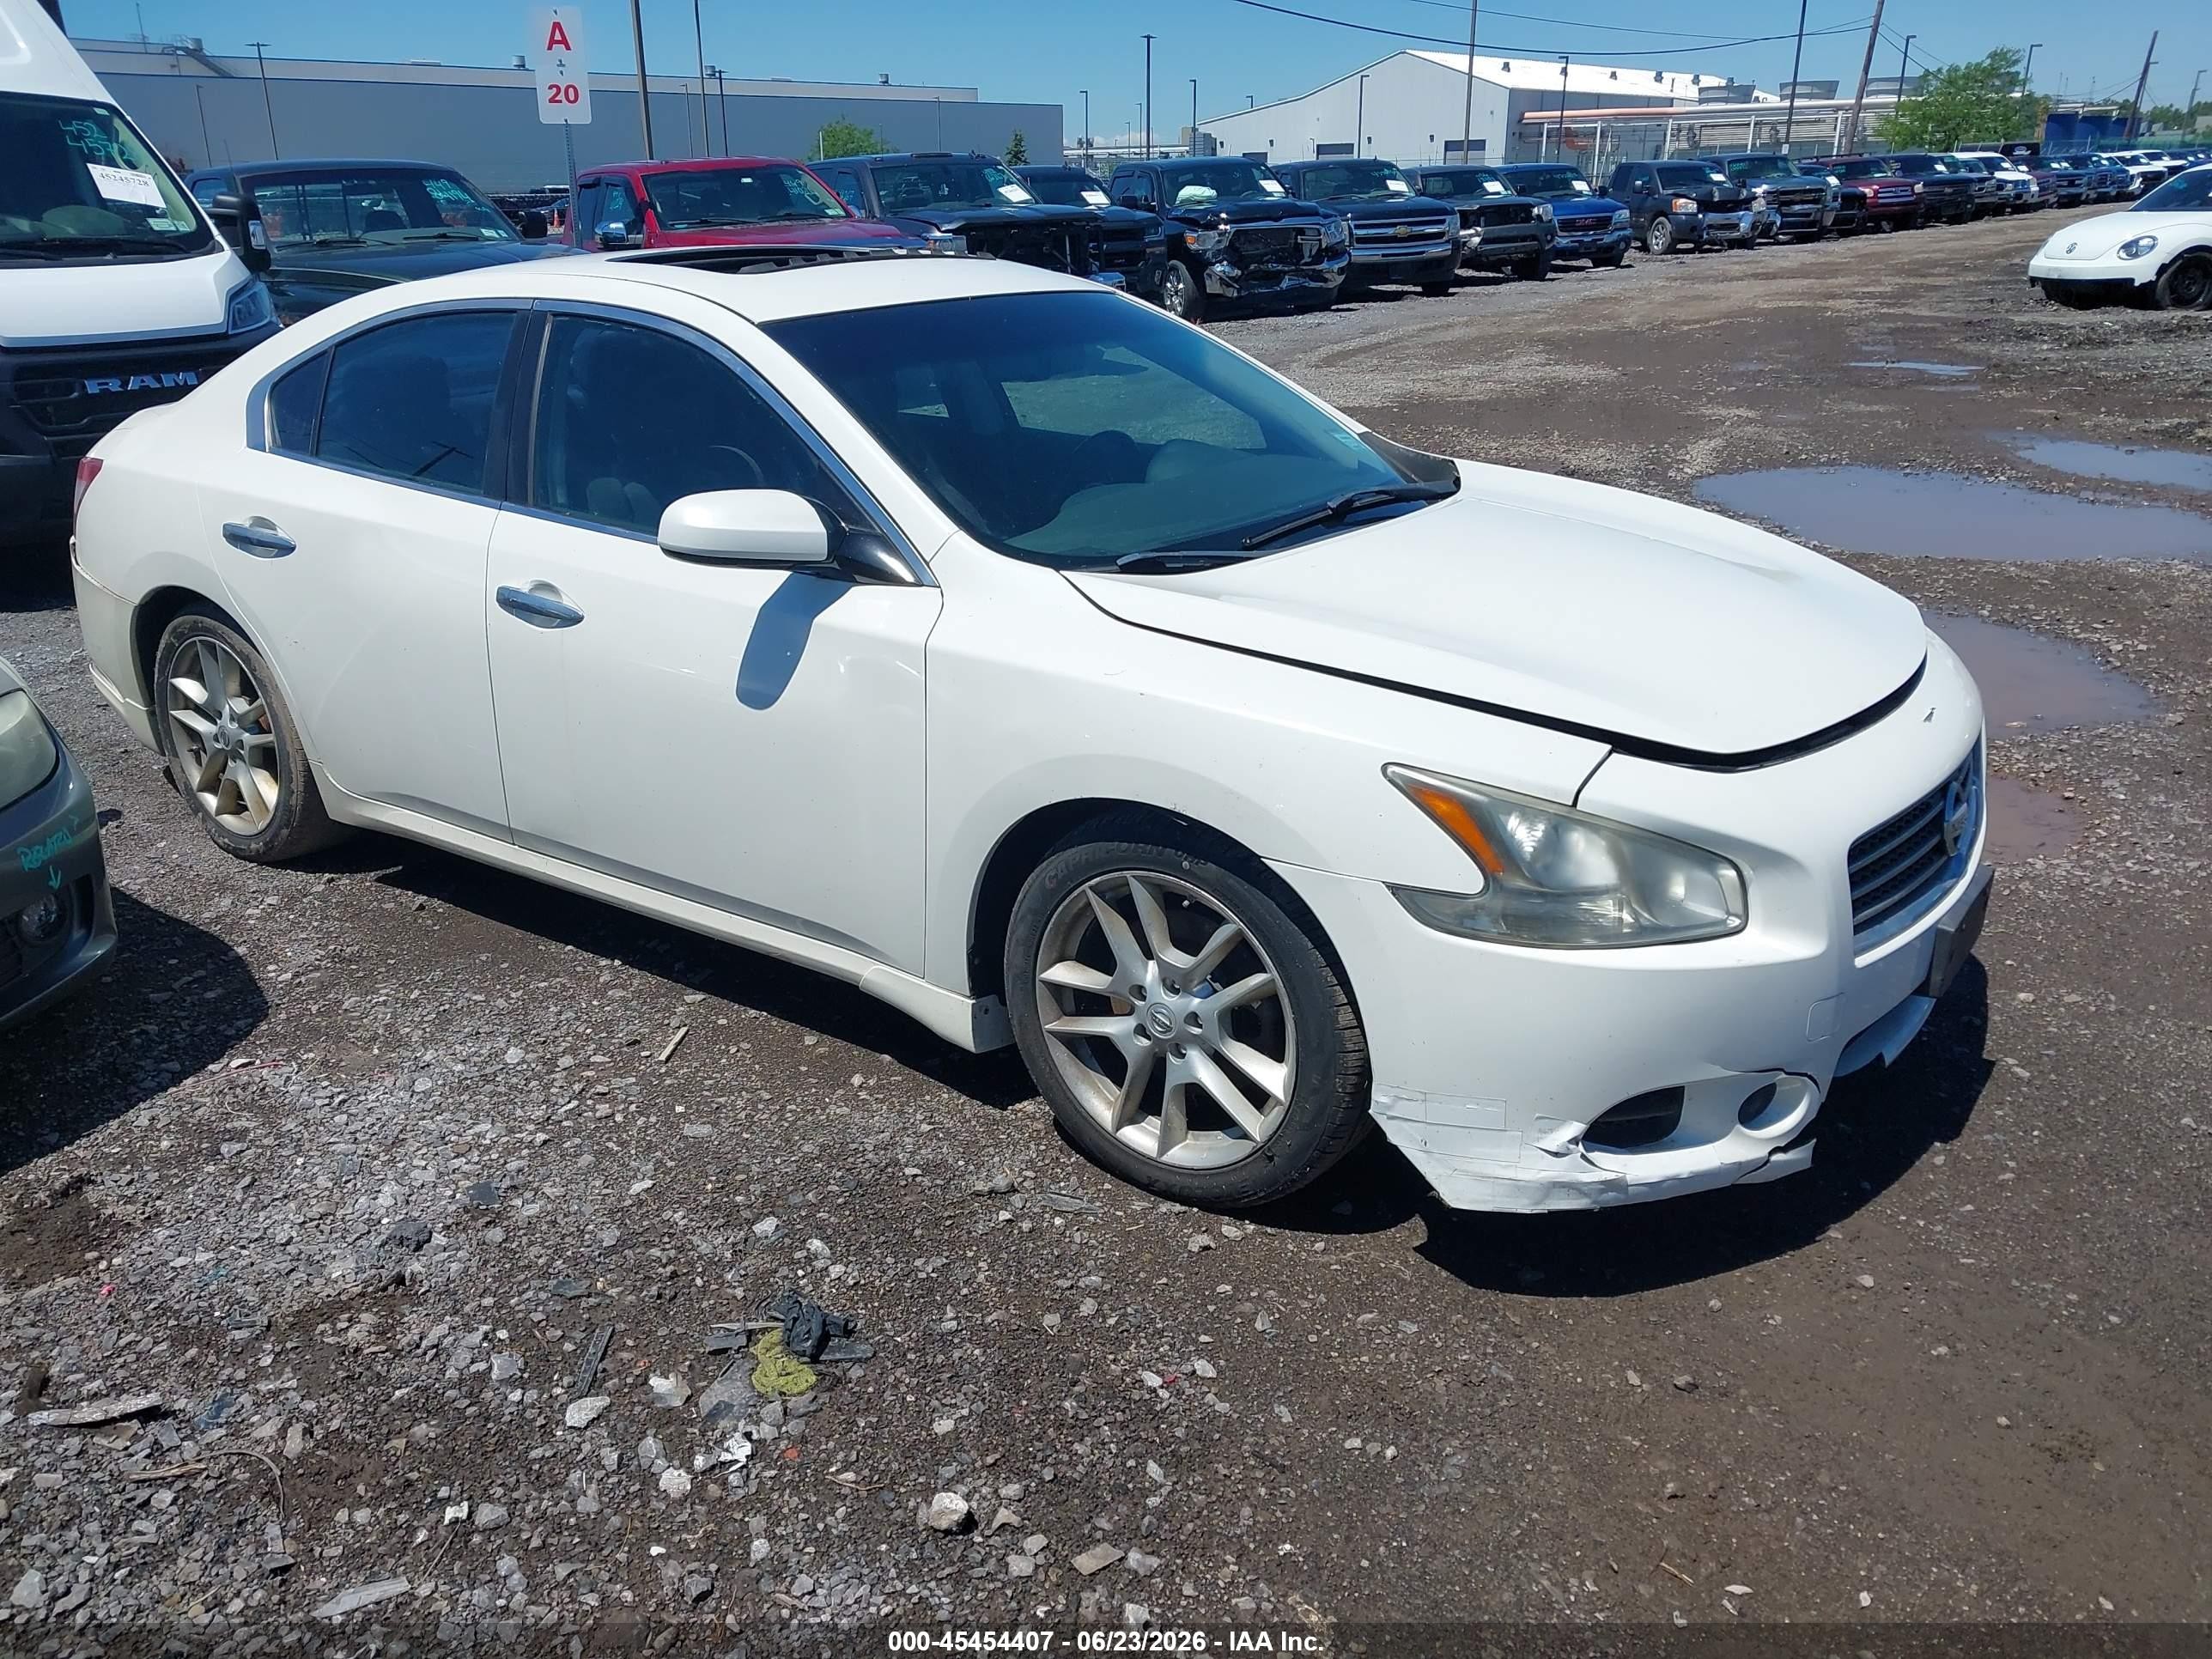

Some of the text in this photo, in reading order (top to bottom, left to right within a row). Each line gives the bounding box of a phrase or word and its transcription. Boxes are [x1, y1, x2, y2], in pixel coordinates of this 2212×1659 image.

[547, 21, 572, 51] A
[547, 83, 580, 104] 20
[84, 372, 198, 393] RAM
